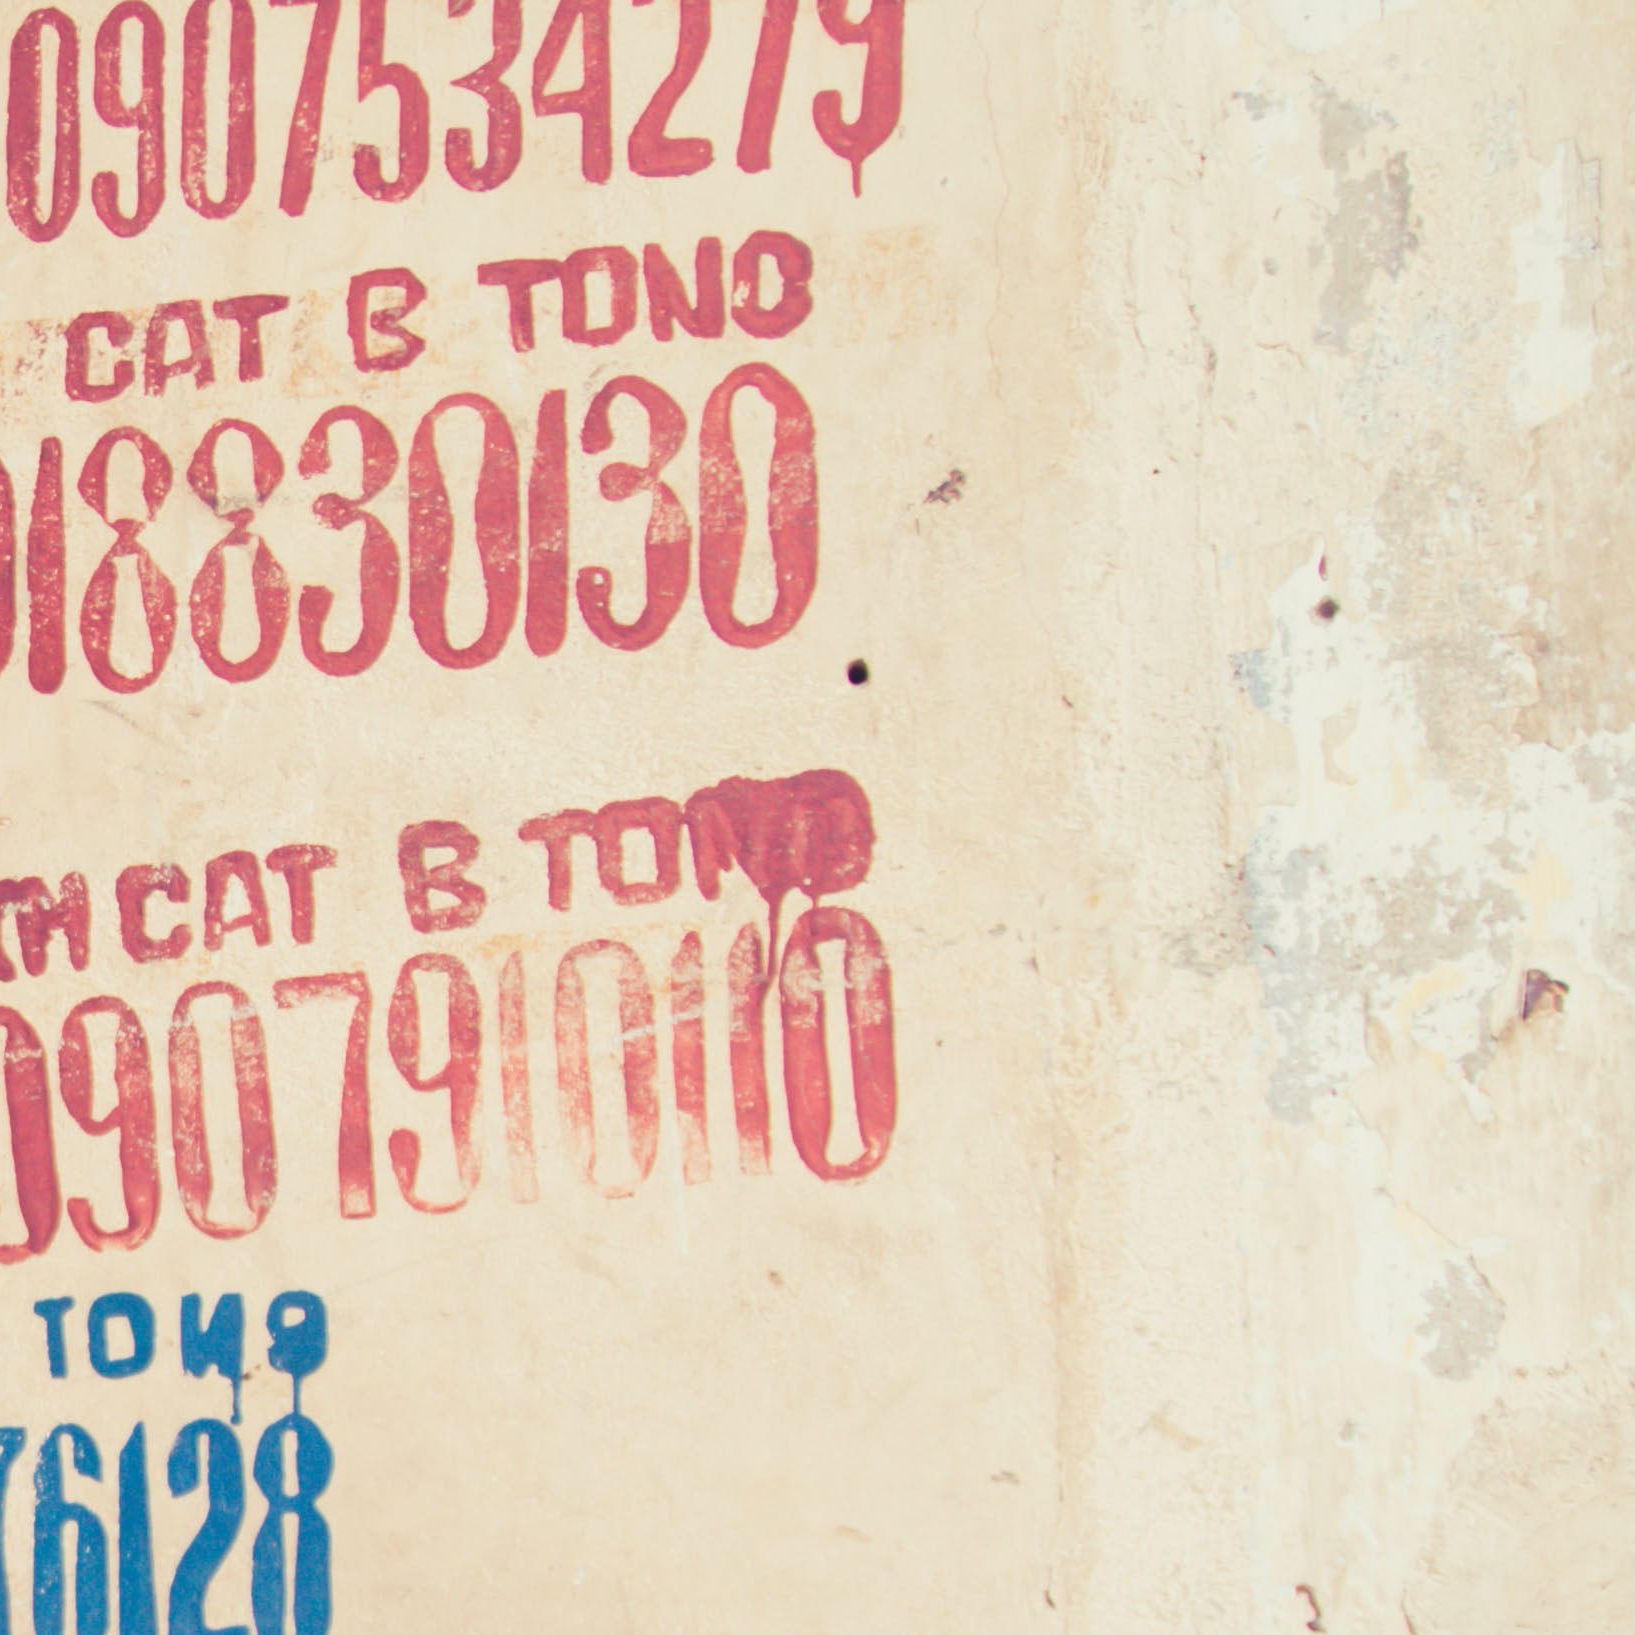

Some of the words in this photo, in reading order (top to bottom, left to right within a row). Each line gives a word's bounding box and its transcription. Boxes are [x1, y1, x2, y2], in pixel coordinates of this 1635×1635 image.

[6, 0, 903, 243] 0907534279
[64, 300, 289, 403] CAT
[346, 267, 427, 372] B
[116, 843, 339, 963] CAT
[397, 819, 486, 933] B
